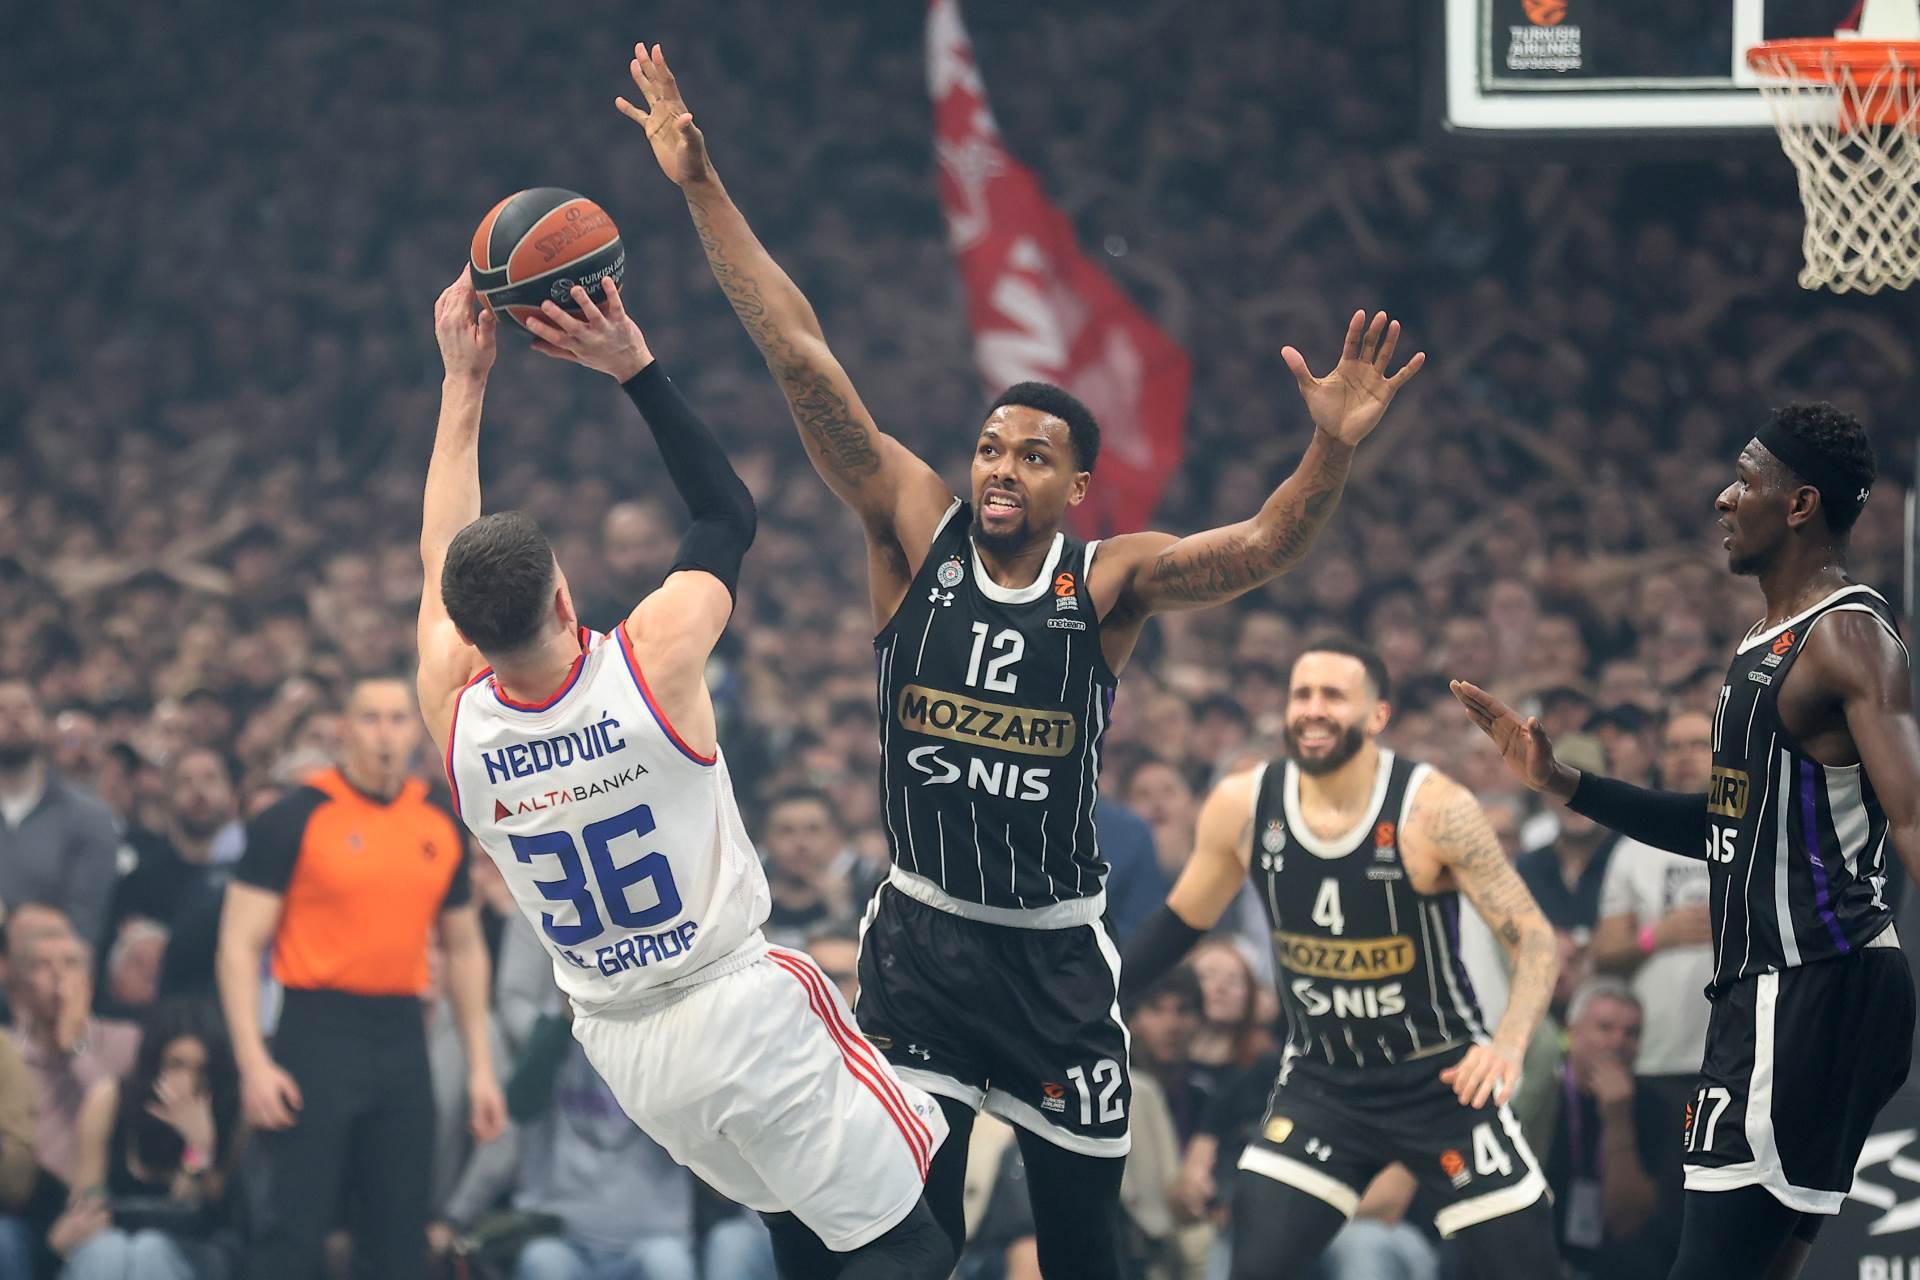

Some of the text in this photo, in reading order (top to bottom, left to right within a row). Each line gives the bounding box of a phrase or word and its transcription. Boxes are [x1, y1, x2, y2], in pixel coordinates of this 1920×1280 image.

[965, 621, 1025, 694] 12
[482, 711, 626, 785] NEDOVIĆ
[902, 693, 1071, 748] MOZZART
[517, 764, 649, 815] ALTABANKA
[967, 757, 1051, 801] NIS
[1706, 824, 1738, 864] IS
[508, 804, 683, 946] 36
[1311, 877, 1345, 936] 4
[1332, 981, 1406, 1019] NIS
[1066, 1059, 1125, 1125] 12
[1686, 1087, 1732, 1153] 17
[1471, 1121, 1513, 1177] 4
